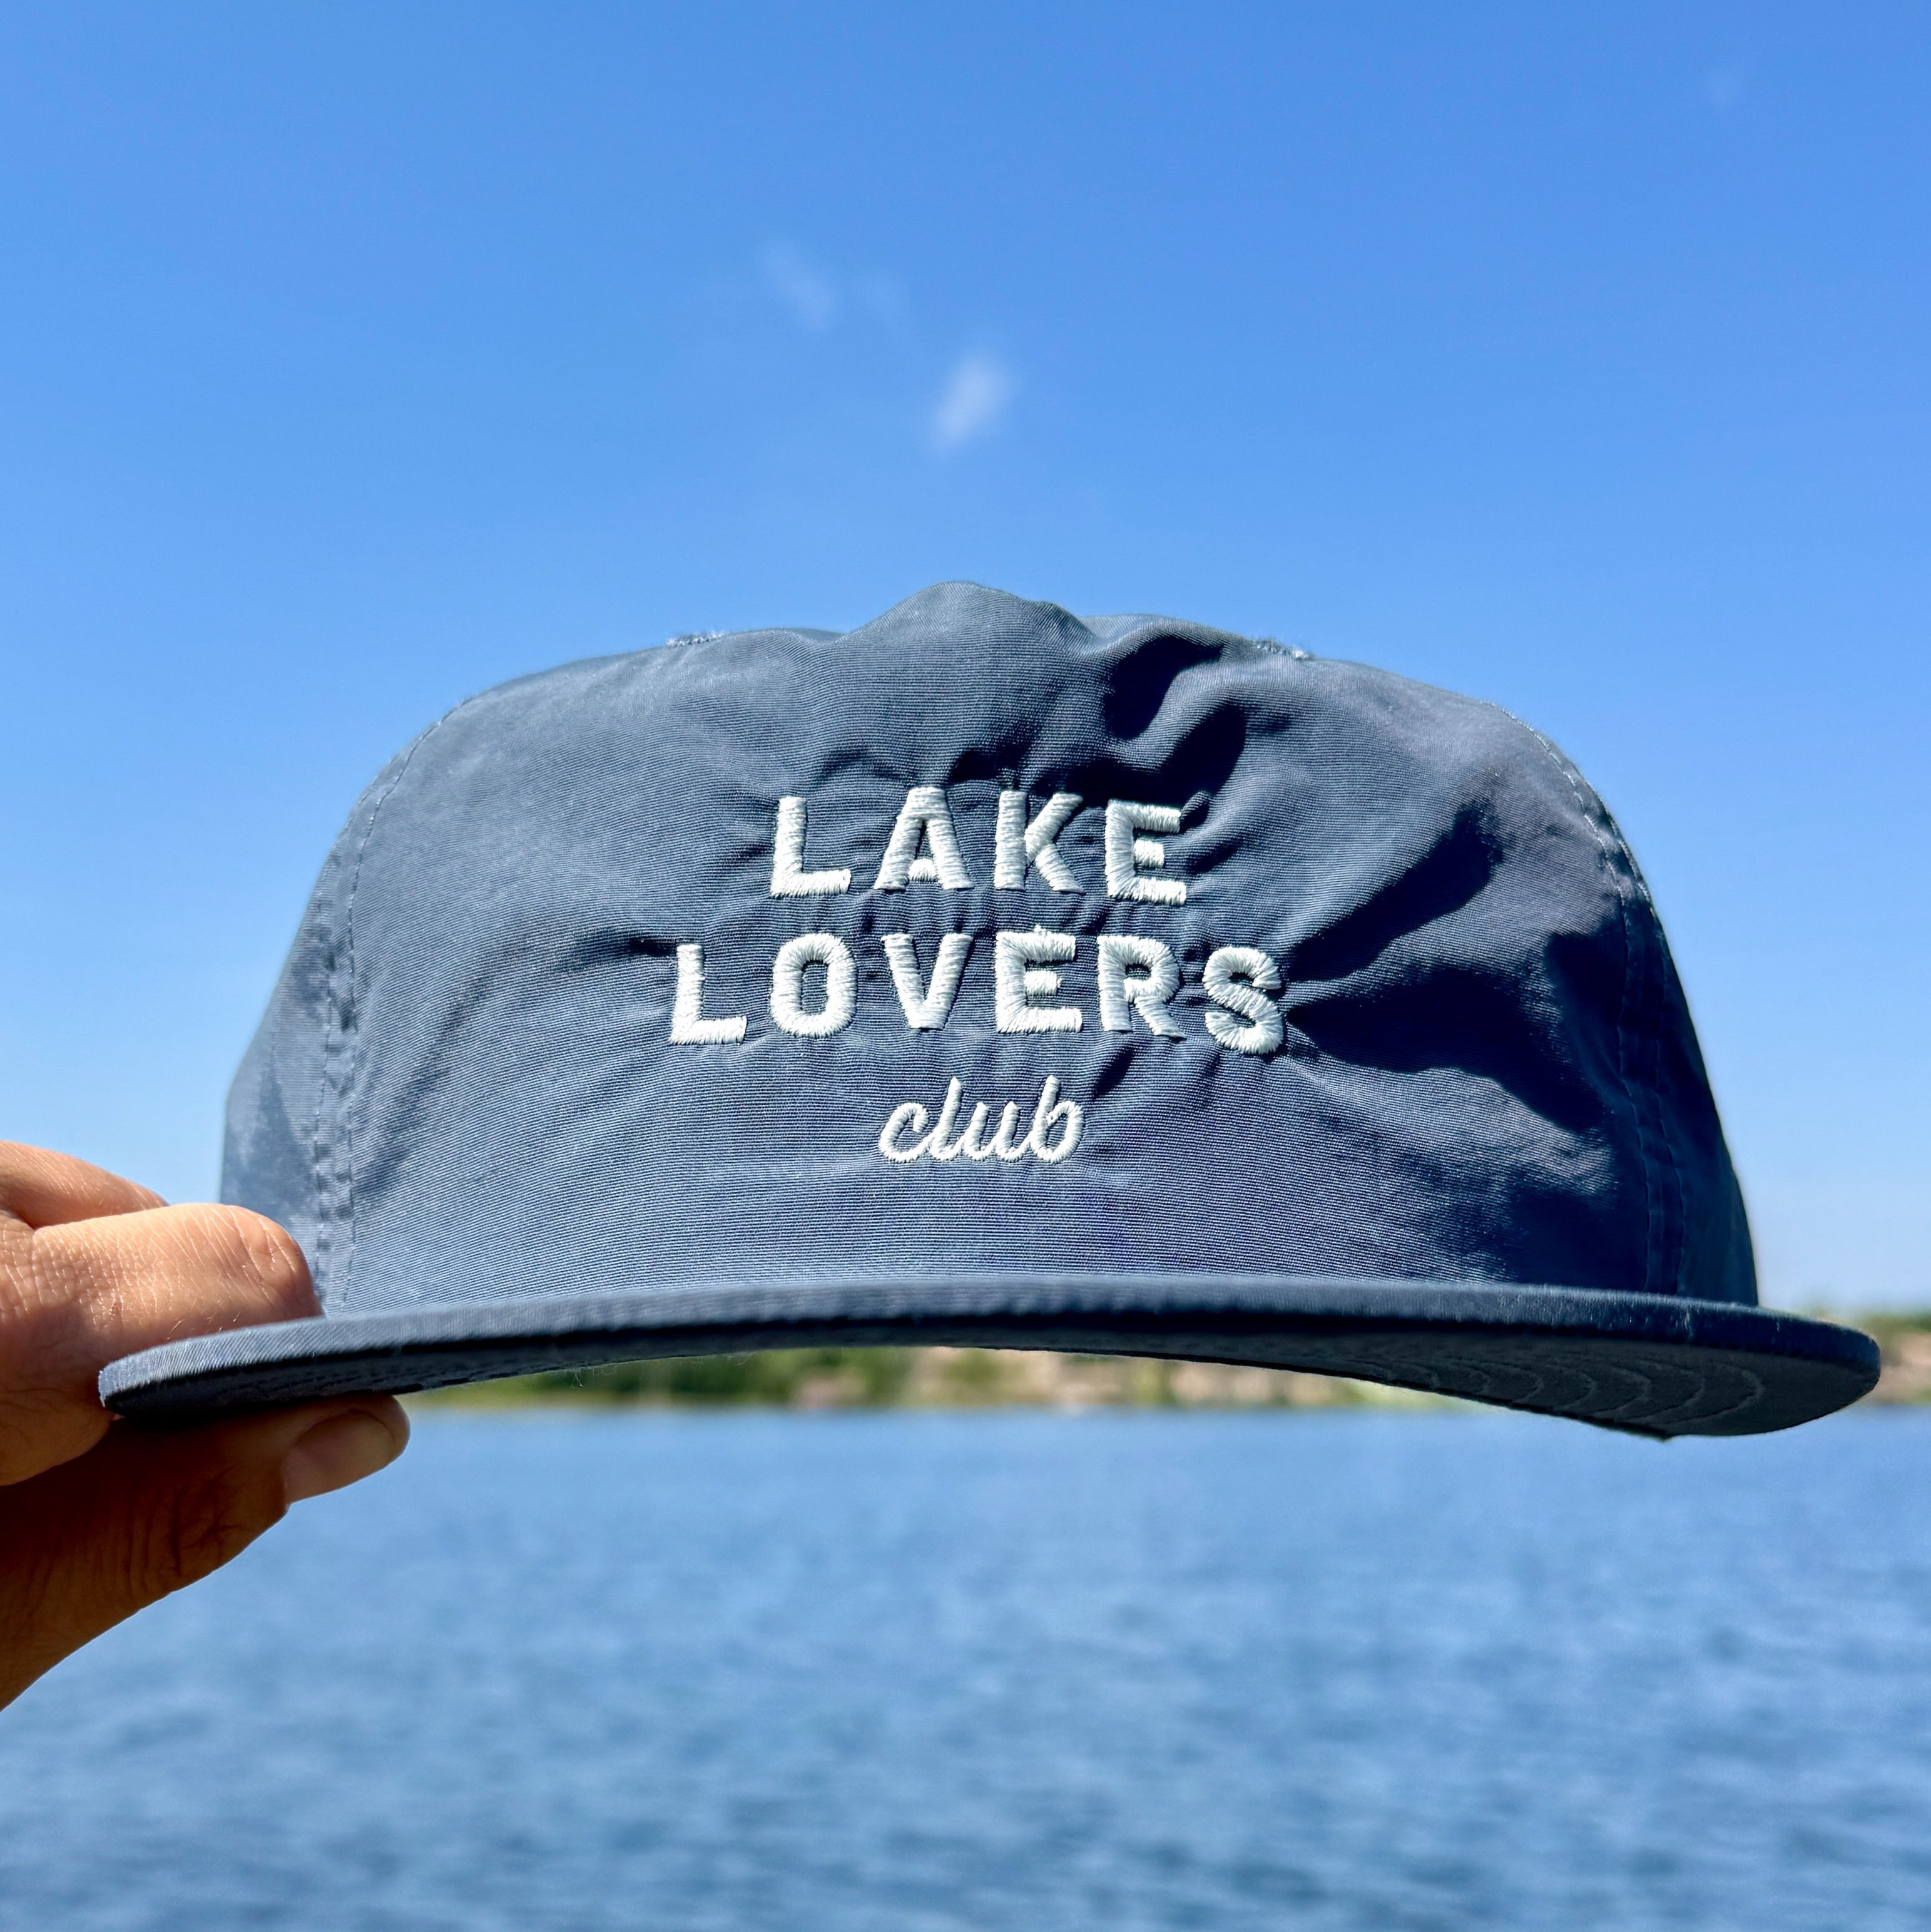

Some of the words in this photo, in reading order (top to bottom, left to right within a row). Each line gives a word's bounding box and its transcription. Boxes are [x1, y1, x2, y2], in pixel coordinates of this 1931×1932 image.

[770, 787, 1188, 905] LAKE
[670, 925, 1284, 1055] LOVERS
[878, 1075, 1084, 1164] club
